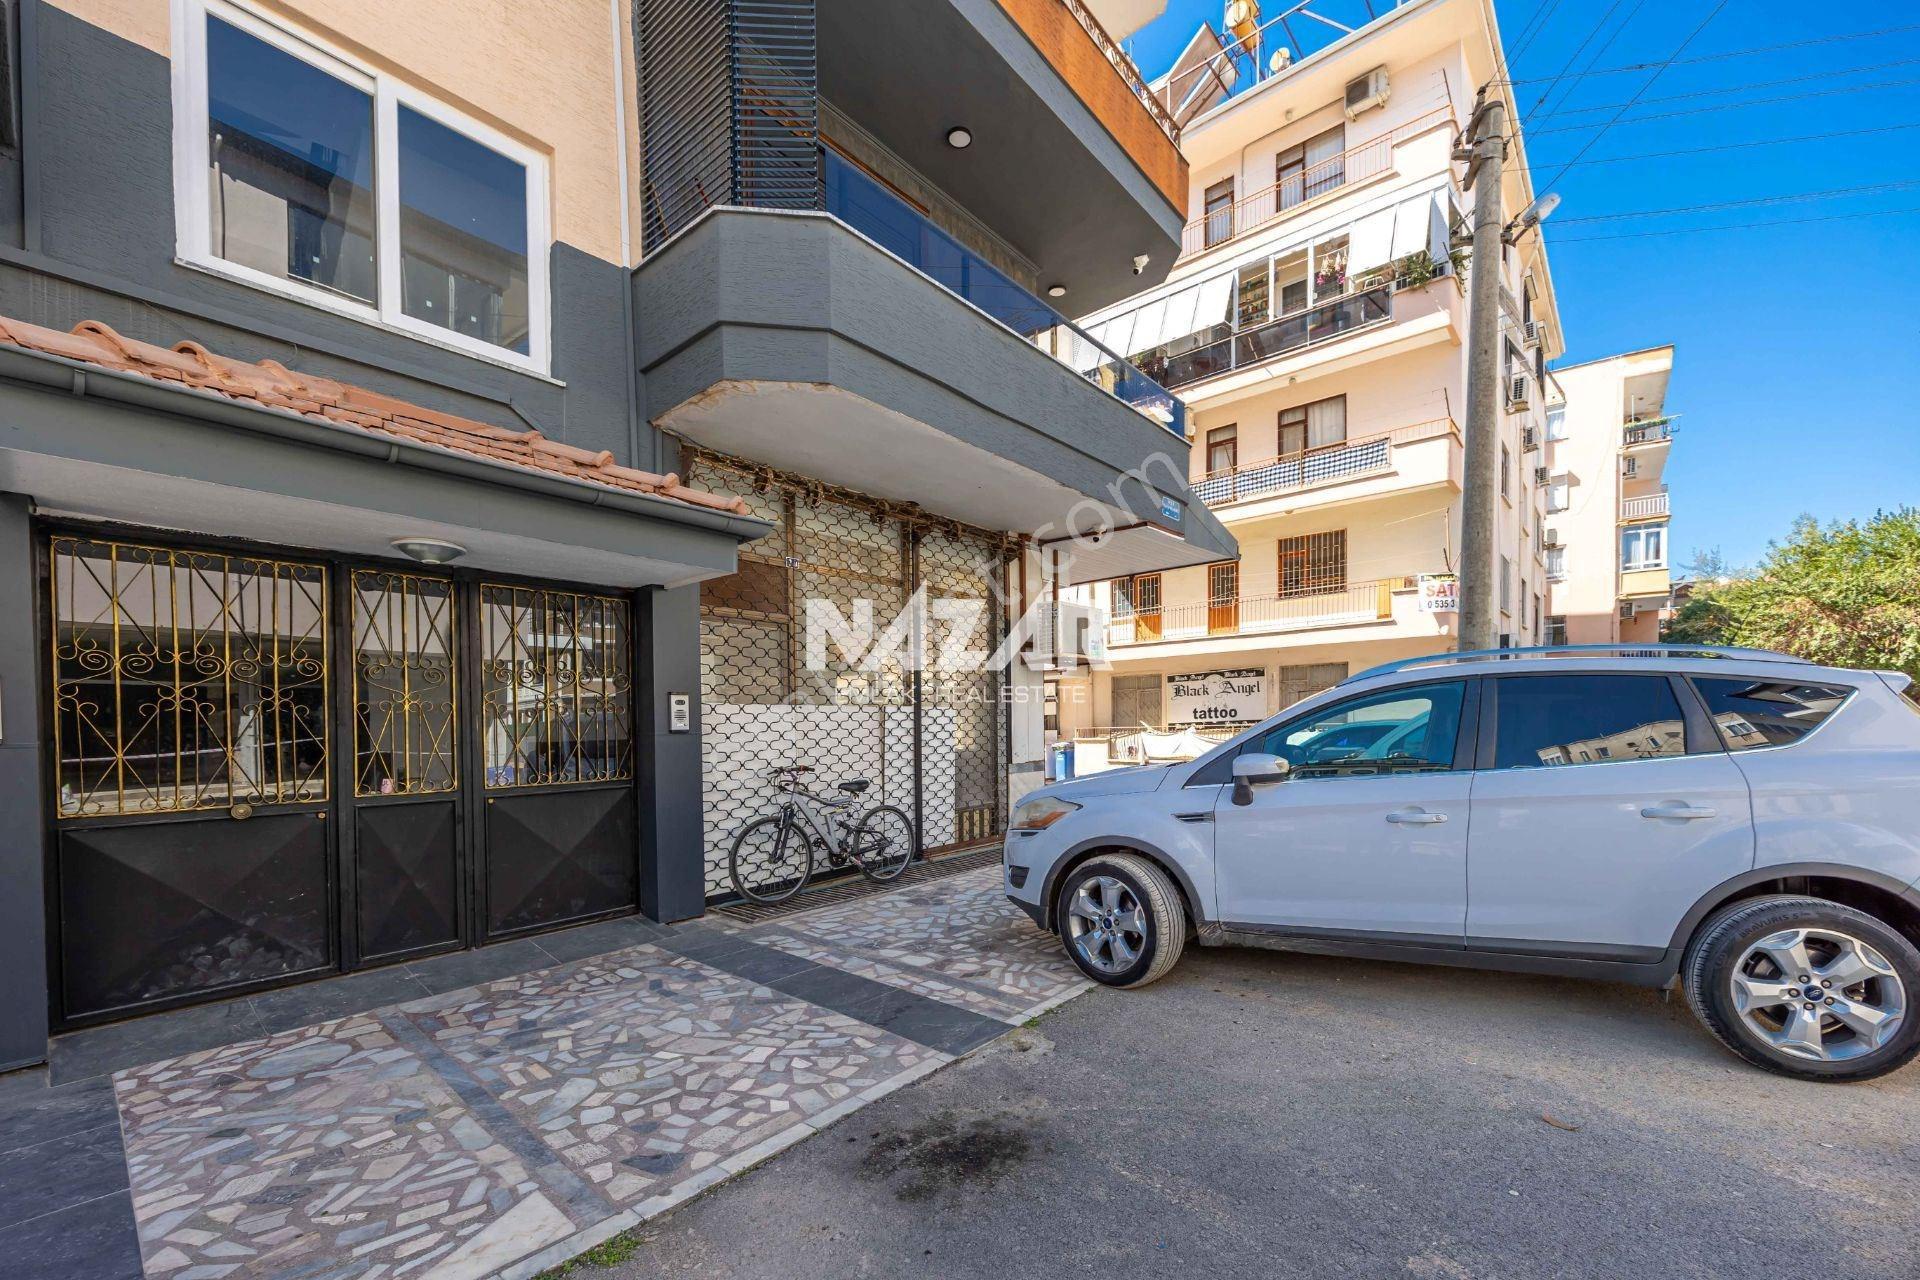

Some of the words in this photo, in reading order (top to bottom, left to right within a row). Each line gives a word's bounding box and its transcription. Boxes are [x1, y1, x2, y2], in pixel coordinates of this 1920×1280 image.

[1427, 600, 1433, 609] 0
[1171, 684, 1210, 700] Black
[1215, 681, 1261, 698] Angel
[1192, 706, 1238, 720] tattoo
